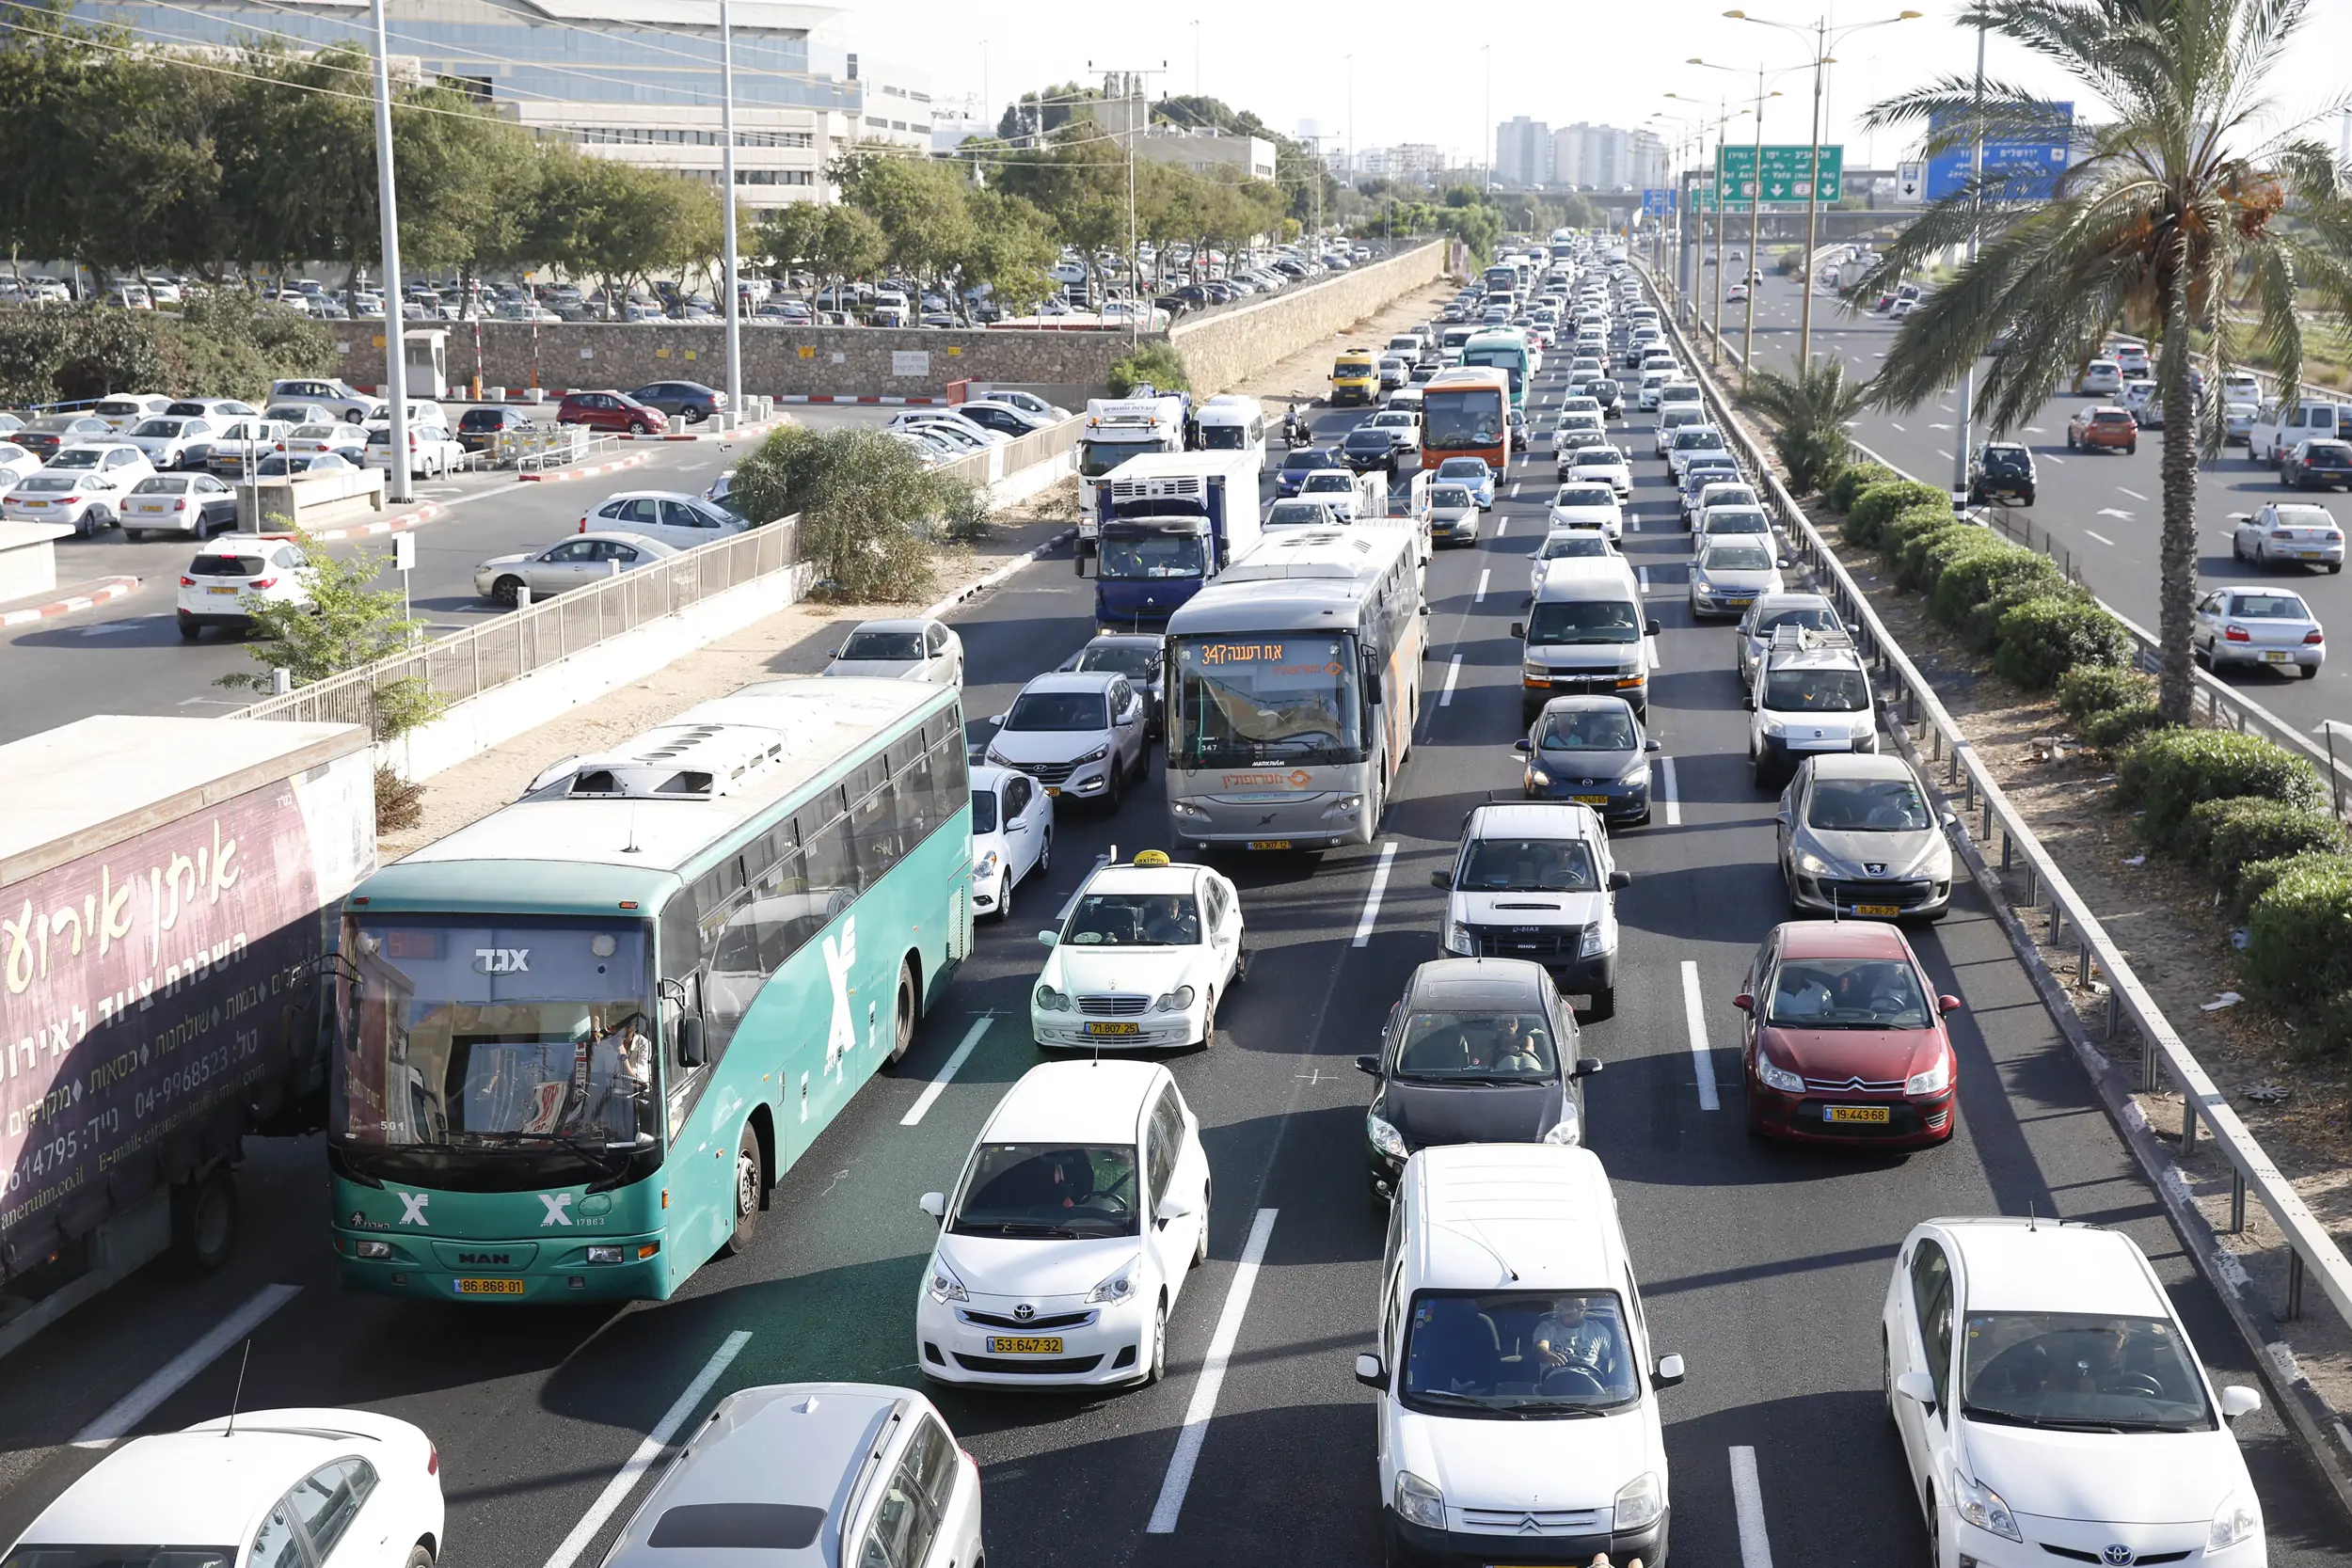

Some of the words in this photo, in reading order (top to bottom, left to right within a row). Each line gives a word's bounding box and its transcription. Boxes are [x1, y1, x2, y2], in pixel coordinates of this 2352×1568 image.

[1201, 644, 1227, 665] 347
[1228, 645, 1261, 661] רעננה
[1221, 773, 1284, 789] מטרופולין
[151, 818, 240, 968] איתן
[164, 931, 247, 999] השכרת
[475, 948, 530, 972] אגד
[98, 975, 154, 1029] ציוד
[225, 985, 259, 1022] במות
[0, 1004, 87, 1083] לאירו
[154, 1009, 209, 1058] שולחנות
[89, 1047, 138, 1095] כסאות
[135, 1045, 229, 1119] 04-9968523
[8, 1084, 72, 1138] מקררים
[380, 1120, 405, 1132] 501
[577, 1217, 605, 1227] 17863
[458, 1253, 510, 1264] MAN
